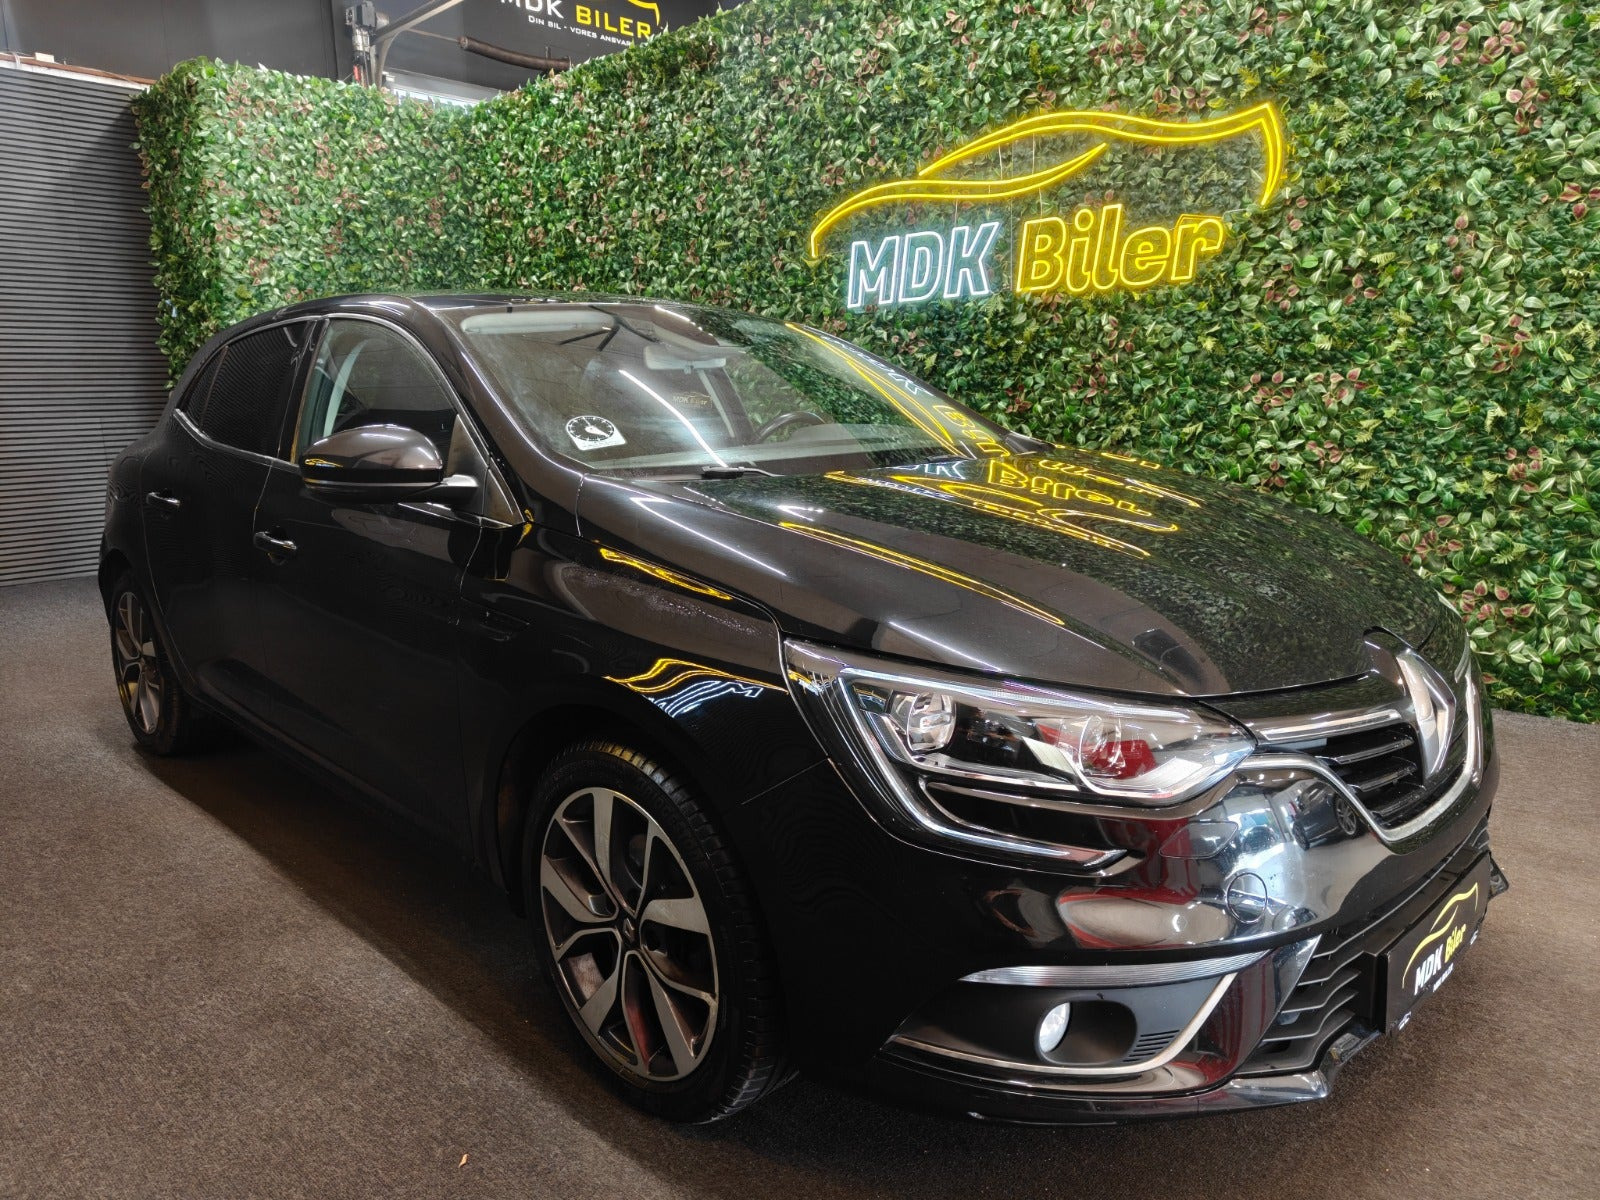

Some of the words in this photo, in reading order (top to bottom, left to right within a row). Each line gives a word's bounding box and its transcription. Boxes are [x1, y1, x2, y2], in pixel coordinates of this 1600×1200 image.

[528, 15, 545, 26] DIN
[548, 21, 561, 30] BIL
[570, 26, 597, 39] VORES
[575, 4, 652, 39] BILER
[846, 220, 1002, 310] MDK
[1015, 203, 1226, 294] Biler
[1414, 943, 1444, 996] MDK
[1444, 923, 1466, 963] Biler
